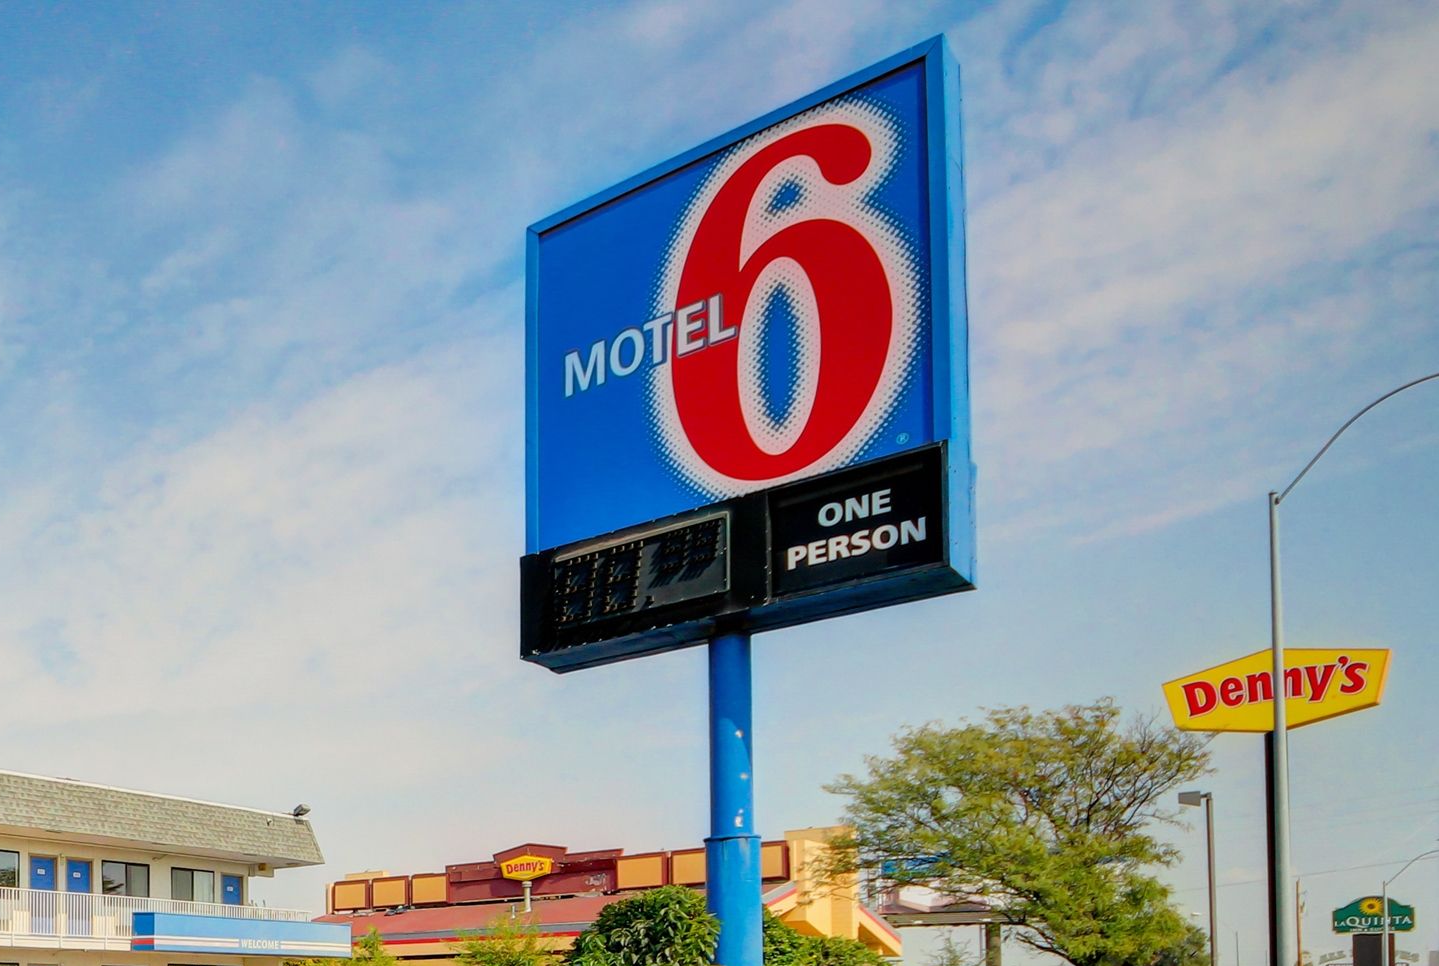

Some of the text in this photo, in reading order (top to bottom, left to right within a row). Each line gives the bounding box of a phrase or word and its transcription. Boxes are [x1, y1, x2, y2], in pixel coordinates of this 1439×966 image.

[563, 120, 895, 483] MOTEL 6
[817, 488, 892, 528] ONE
[786, 516, 927, 571] PERSON
[1180, 655, 1368, 717] Denny's
[506, 861, 545, 874] Denny's
[241, 938, 280, 950] WELCOME
